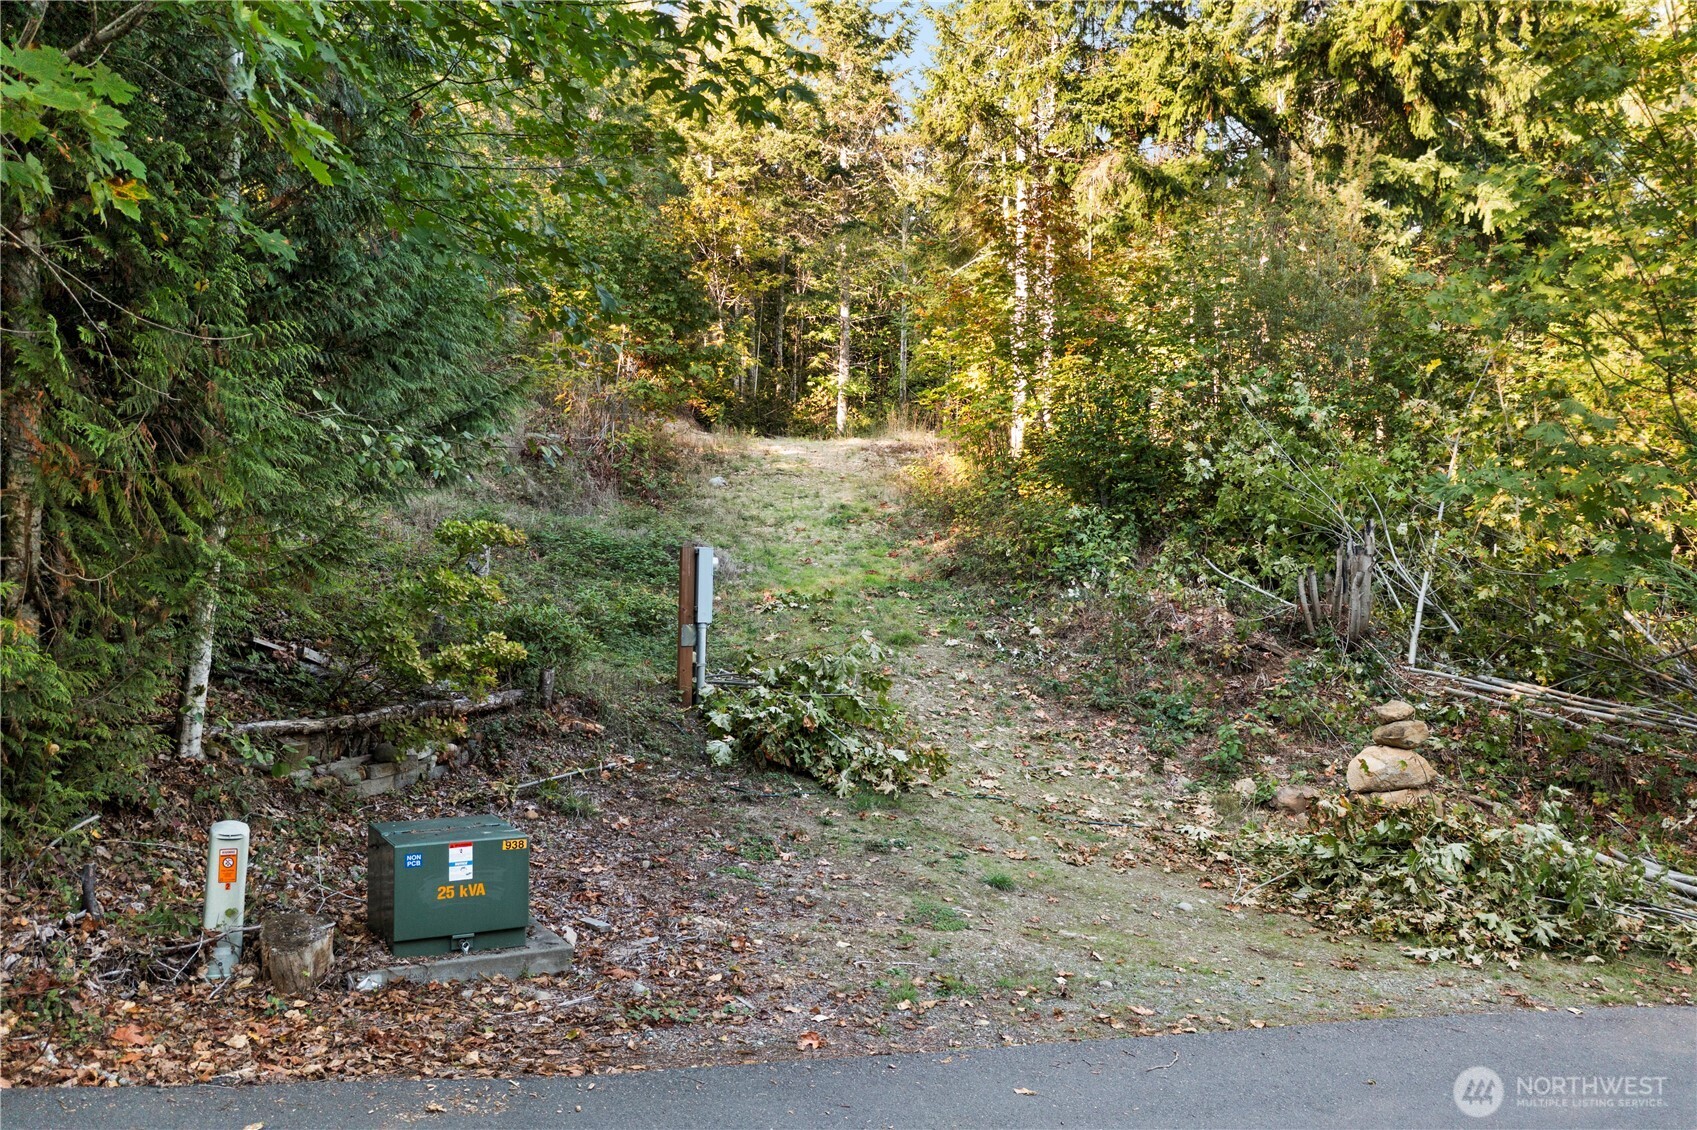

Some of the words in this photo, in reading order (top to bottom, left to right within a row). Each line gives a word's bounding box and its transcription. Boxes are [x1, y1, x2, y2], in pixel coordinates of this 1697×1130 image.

[505, 840, 525, 850] 938
[437, 885, 455, 900] 25
[459, 882, 486, 898] kVA
